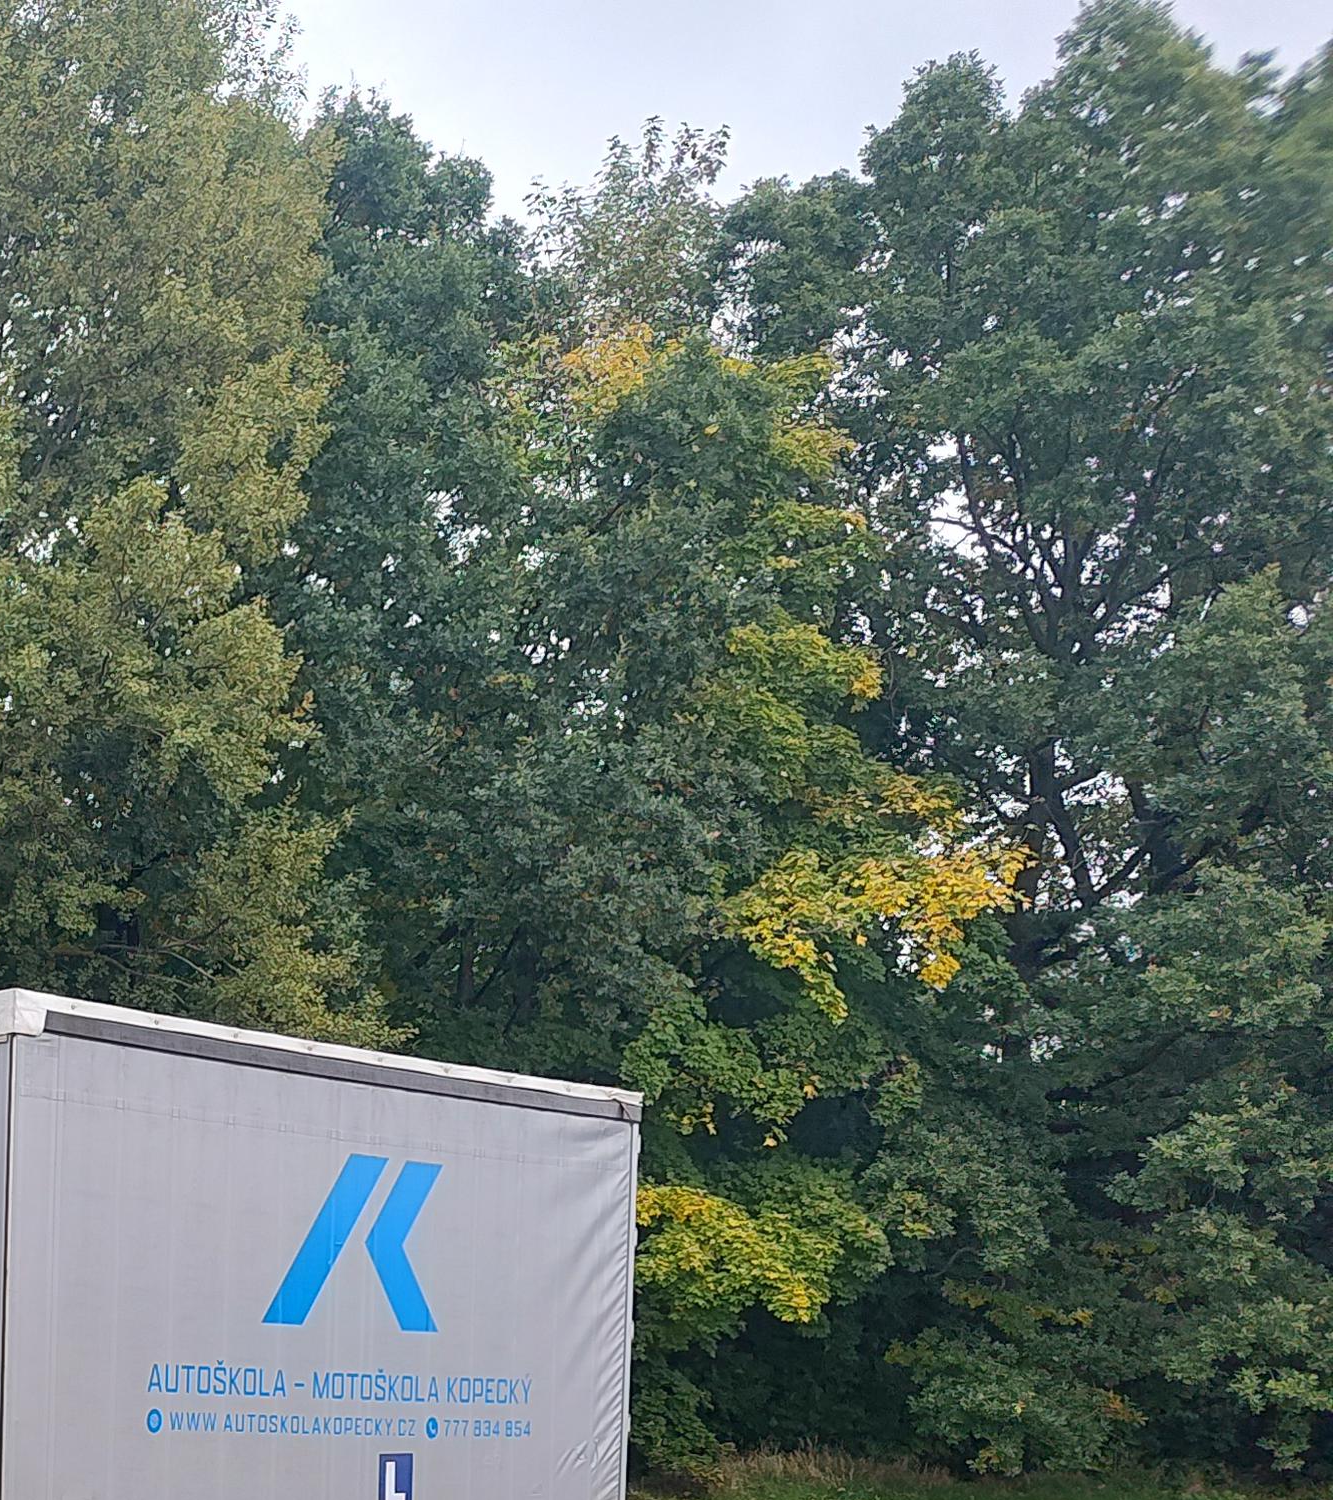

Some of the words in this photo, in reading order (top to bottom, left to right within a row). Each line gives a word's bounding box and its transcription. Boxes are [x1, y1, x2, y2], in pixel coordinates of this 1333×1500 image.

[147, 1359, 287, 1398] AUTOŠKOLA
[312, 1368, 439, 1403] MOTOŠKOLA
[446, 1373, 532, 1405] KOPECKÝ
[443, 1419, 470, 1438] 777
[473, 1419, 500, 1438] 834
[505, 1420, 531, 1438] 854
